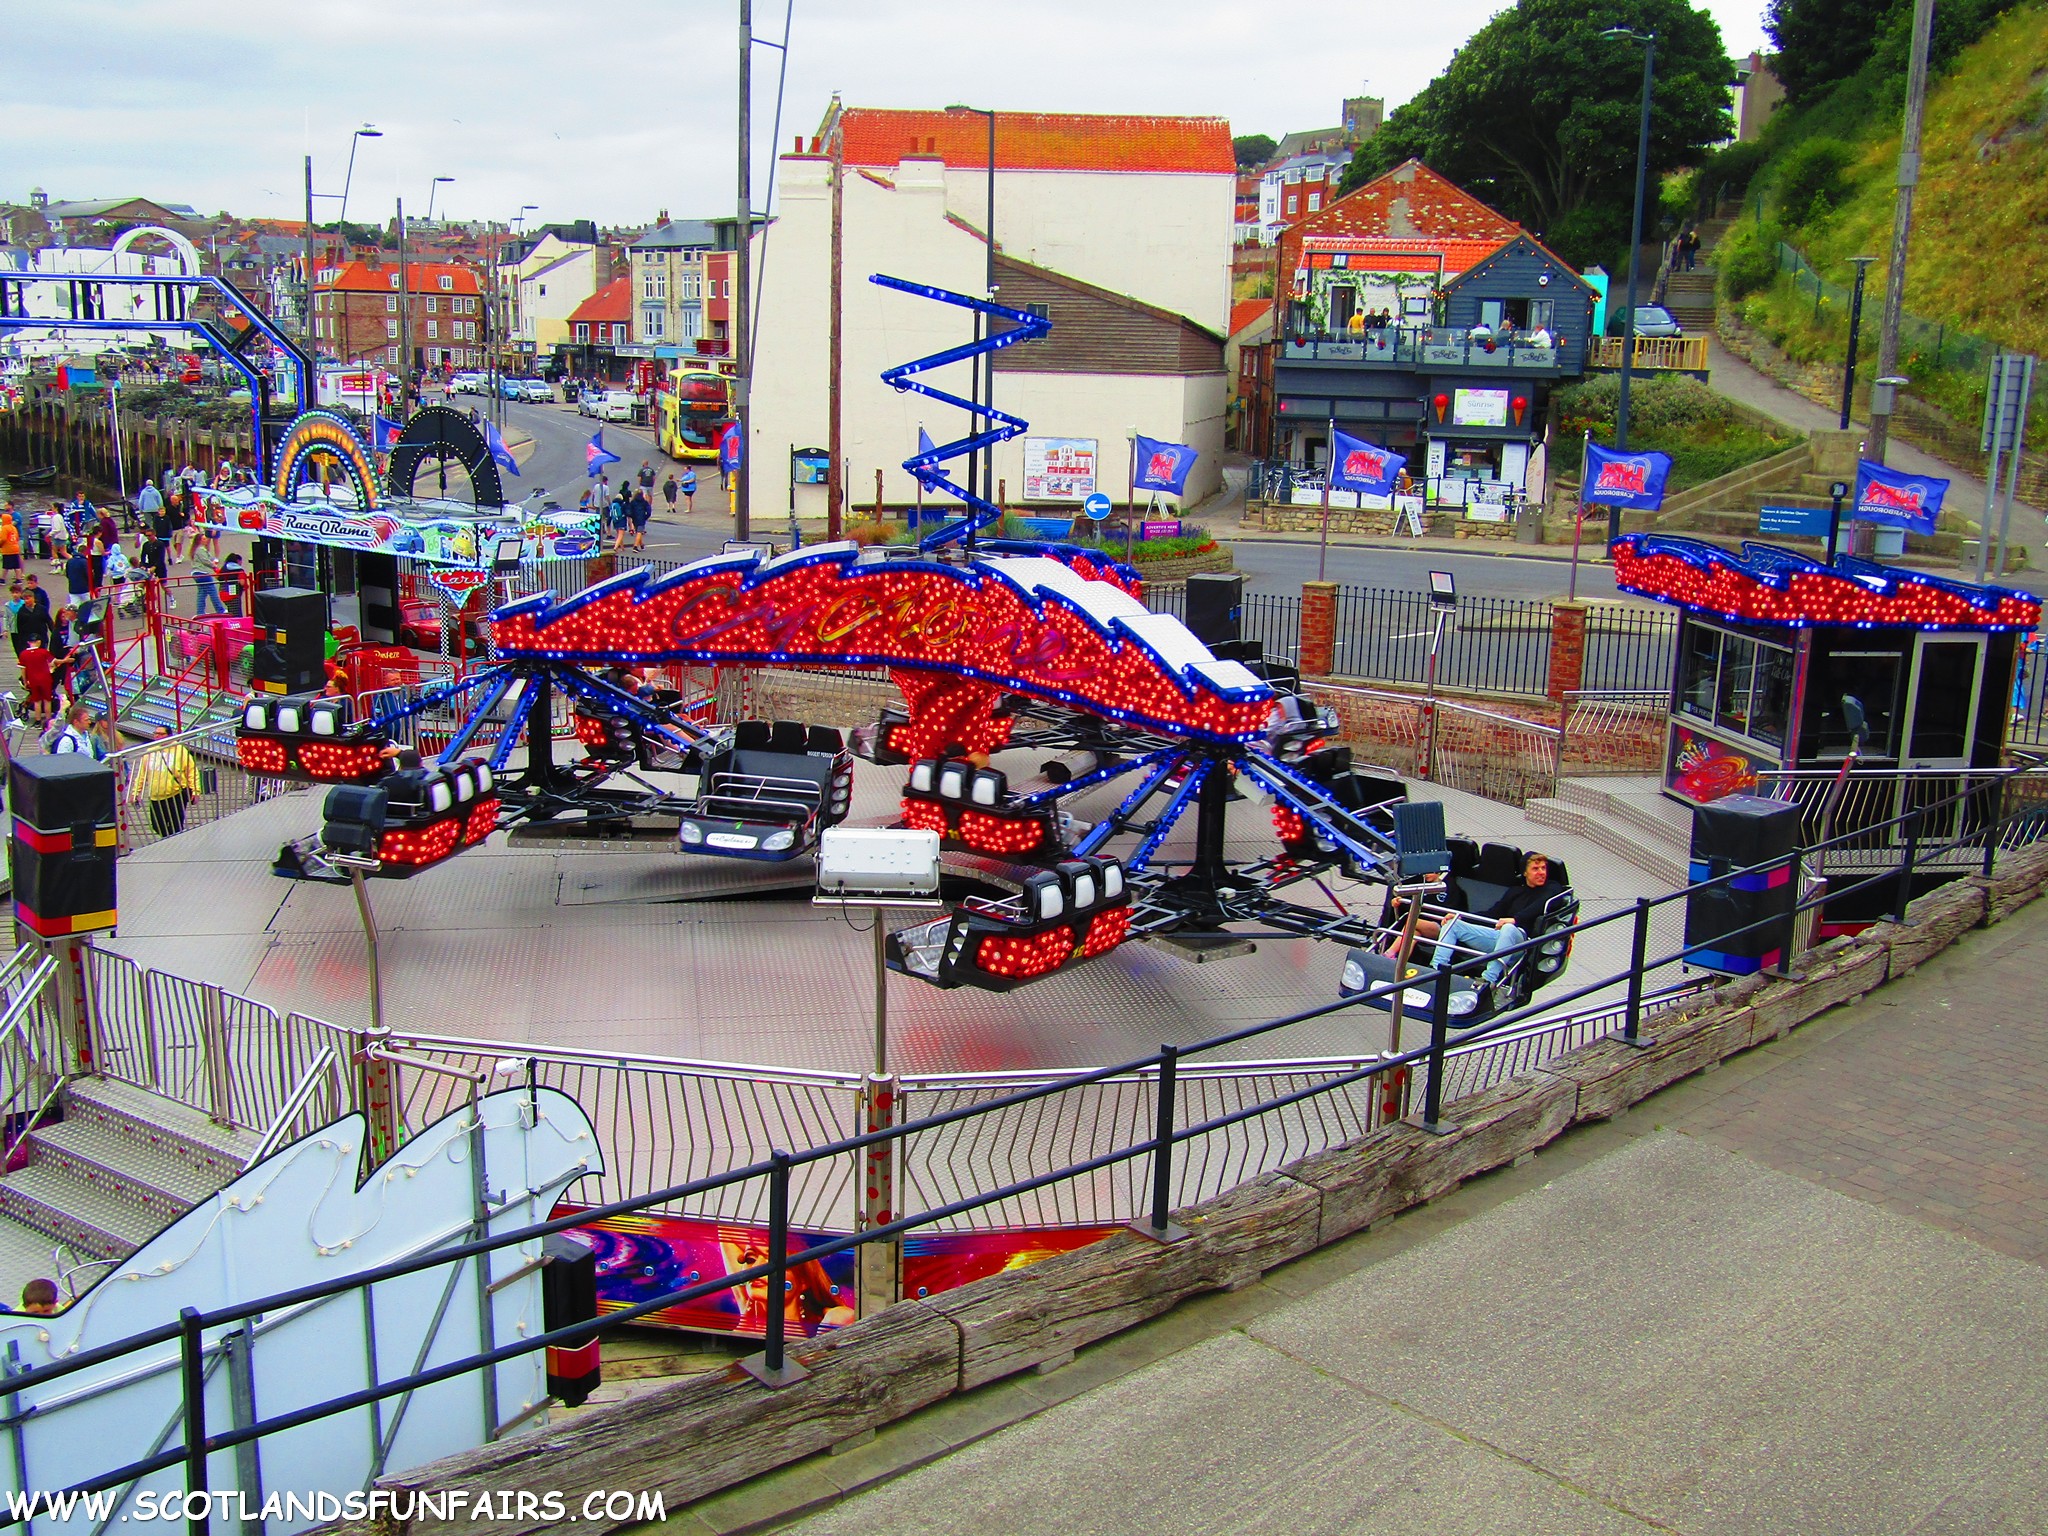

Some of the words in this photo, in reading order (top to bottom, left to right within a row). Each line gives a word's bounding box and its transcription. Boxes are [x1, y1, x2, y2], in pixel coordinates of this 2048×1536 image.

[436, 572, 482, 585] Cars
[670, 580, 1101, 680] Cyclone
[1404, 968, 1418, 979] 9
